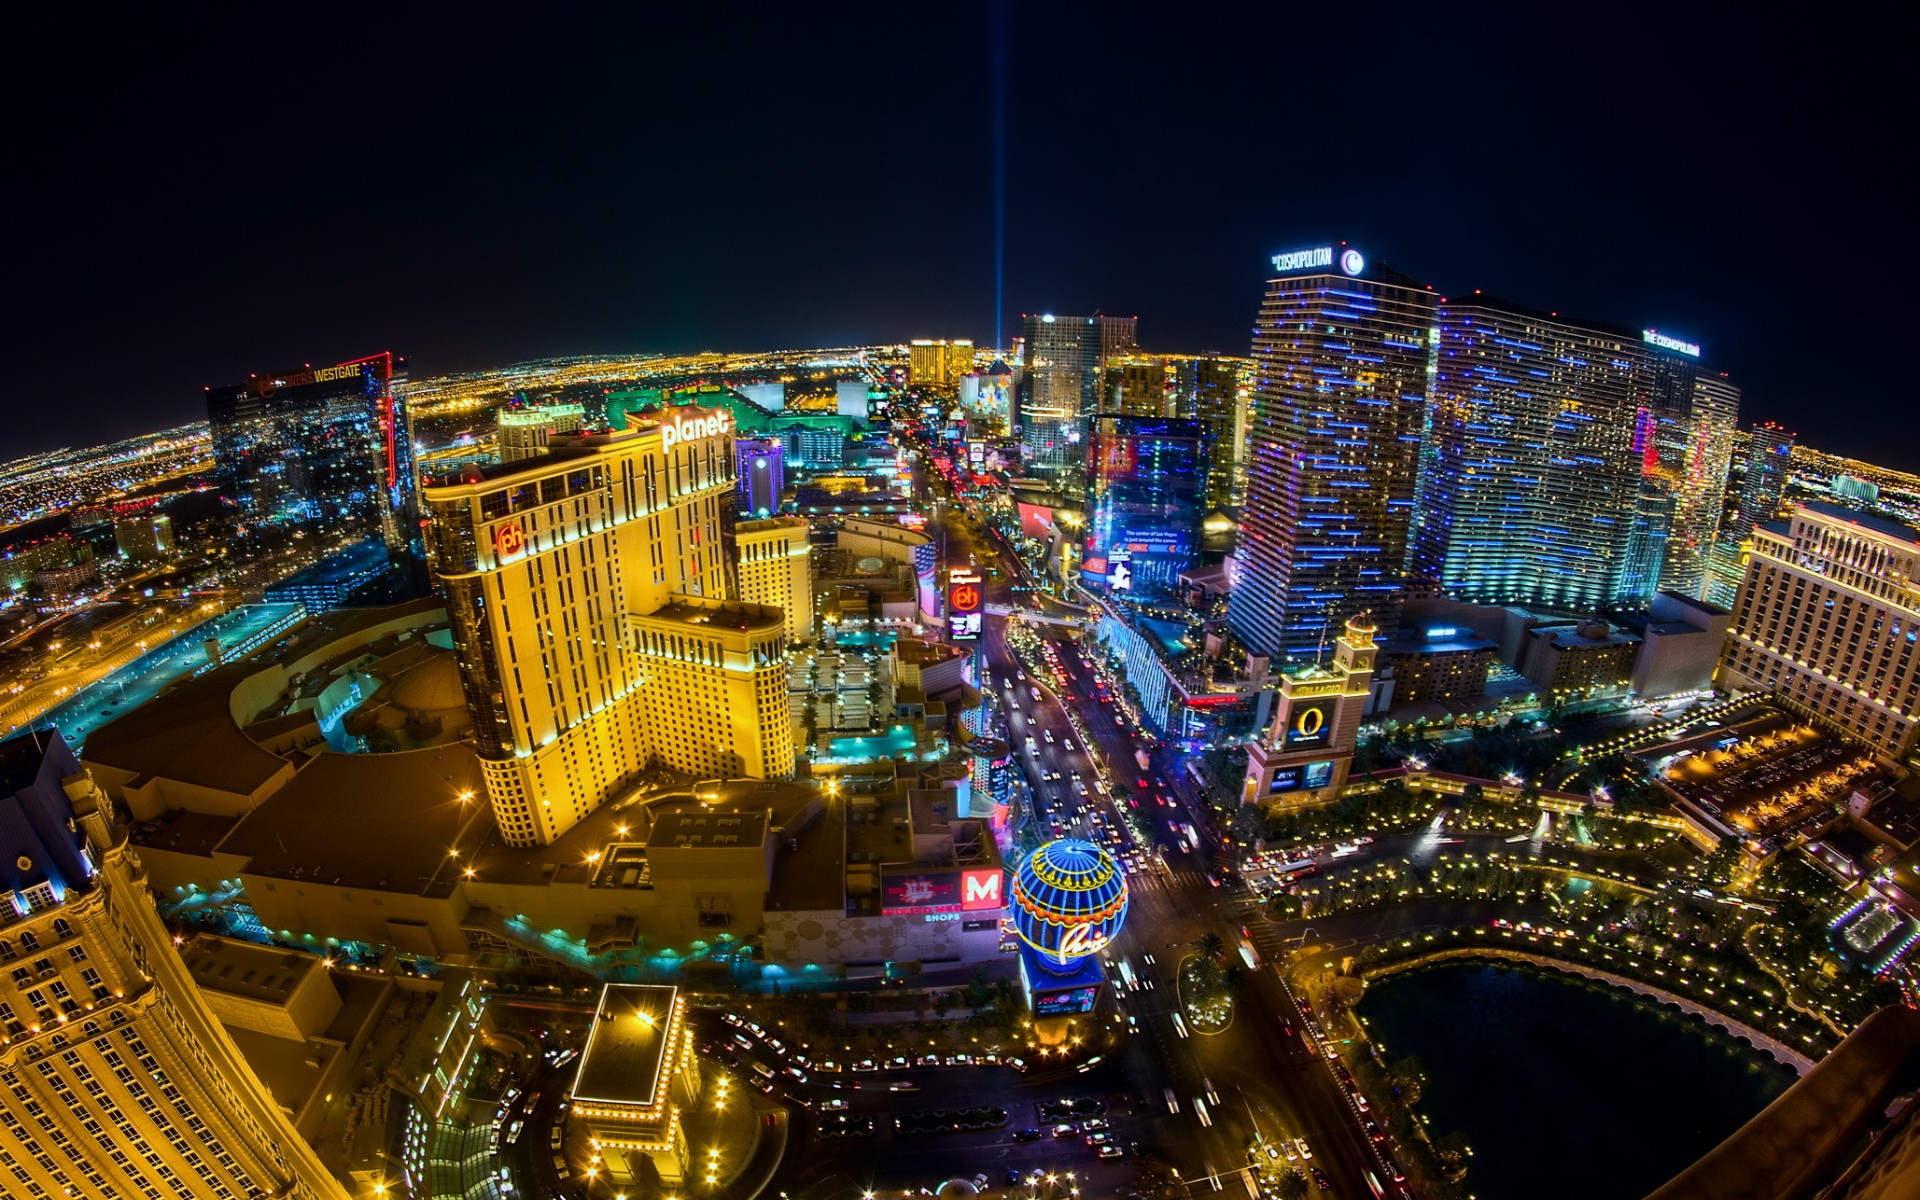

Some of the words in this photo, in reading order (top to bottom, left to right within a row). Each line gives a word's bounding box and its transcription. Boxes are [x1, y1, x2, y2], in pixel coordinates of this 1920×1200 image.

[1277, 247, 1332, 271] COSMOPOLITAN
[1643, 330, 1657, 345] THE
[1657, 335, 1700, 357] COSMOPOLITAN
[314, 363, 361, 383] WESTGATE
[662, 410, 729, 454] planet
[498, 524, 524, 554] ph
[953, 585, 979, 610] ph
[1296, 684, 1341, 695] BELLAGIO
[1297, 707, 1324, 736] O
[966, 874, 999, 902] M
[882, 906, 932, 916] MIRACLE
[924, 913, 961, 923] SHOPS
[1060, 923, 1108, 965] Paris
